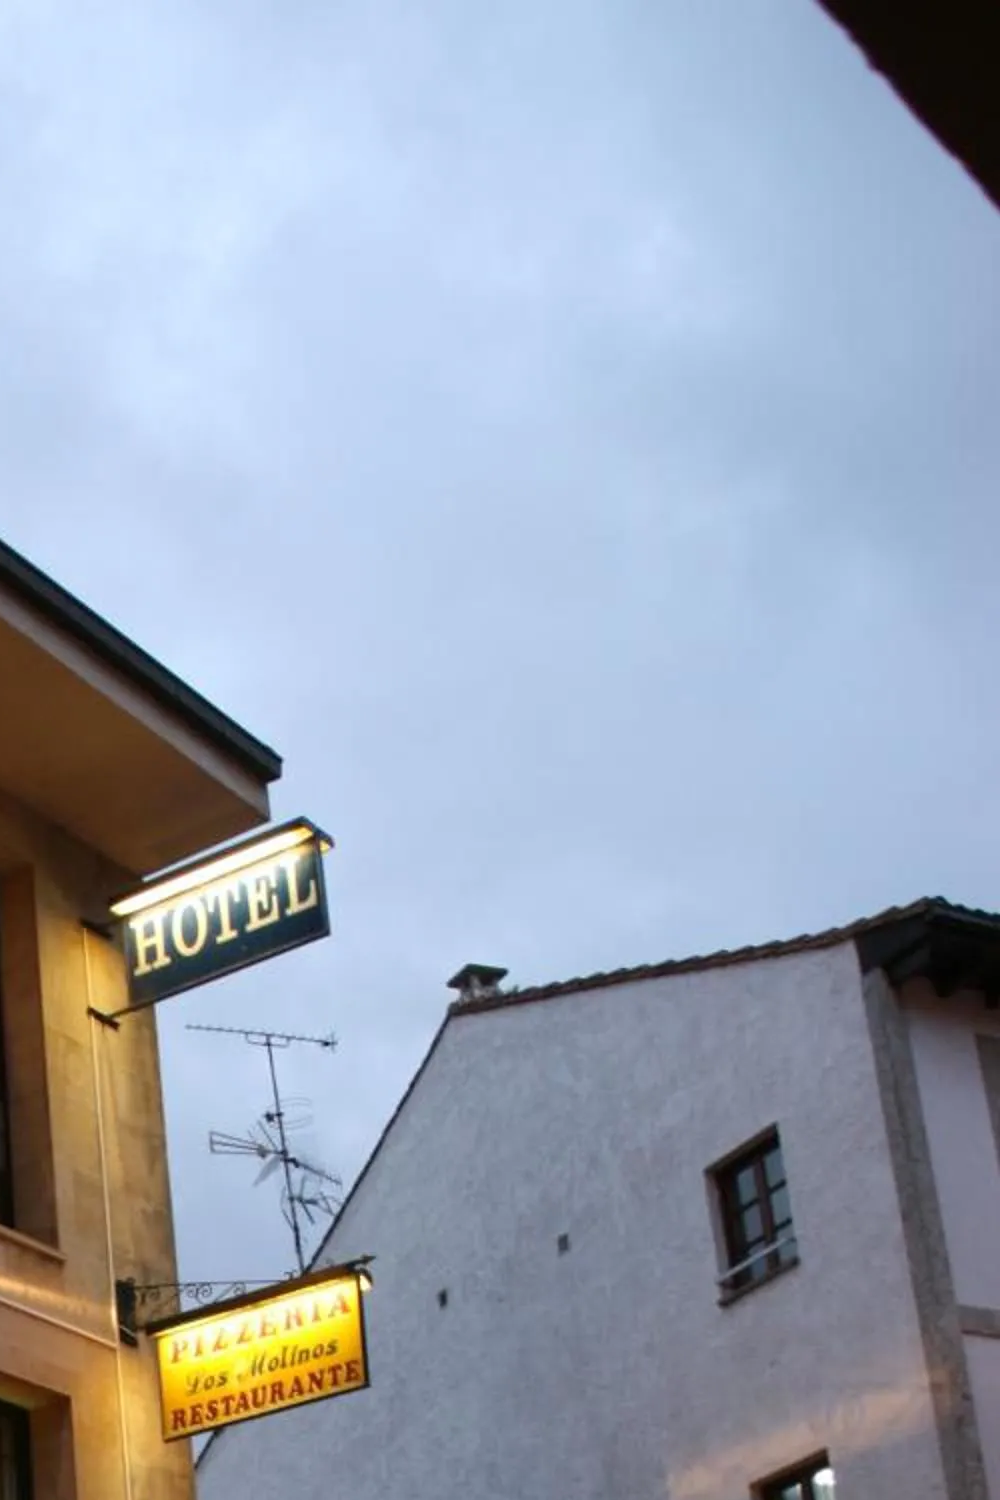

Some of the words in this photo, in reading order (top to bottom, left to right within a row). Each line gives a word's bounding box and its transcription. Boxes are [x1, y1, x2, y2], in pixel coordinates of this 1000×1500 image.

[129, 851, 317, 976] HOTEL
[171, 1293, 352, 1364] PIZZERIA
[171, 1359, 361, 1430] RESTAURANTE
[186, 1370, 229, 1396] Los
[237, 1339, 339, 1382] Molinos
